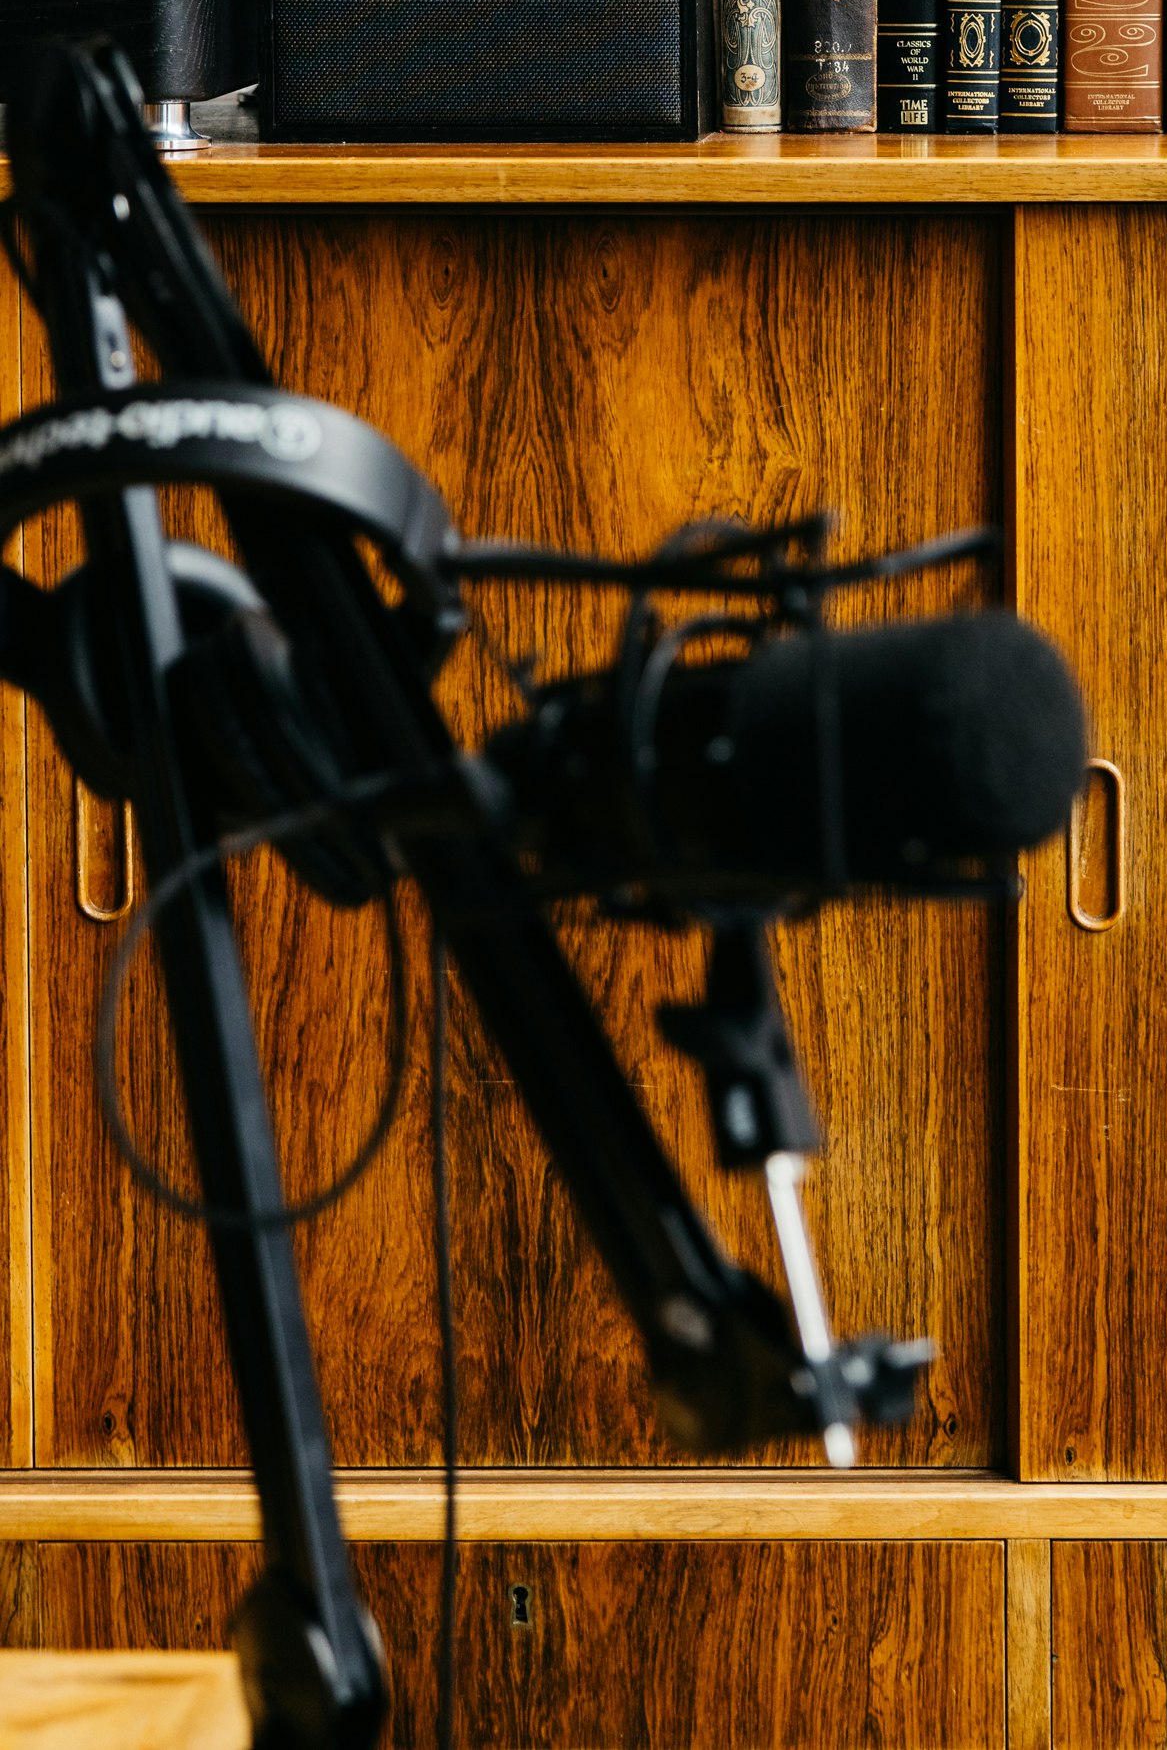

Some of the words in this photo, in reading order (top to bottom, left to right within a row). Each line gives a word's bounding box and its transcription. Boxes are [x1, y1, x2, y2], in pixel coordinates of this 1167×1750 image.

[896, 40, 932, 48] CLASSICS
[910, 48, 922, 56] OF
[900, 56, 929, 64] WORLD
[906, 65, 925, 73] WAR
[899, 99, 929, 111] TIME
[902, 111, 927, 123] LIFE
